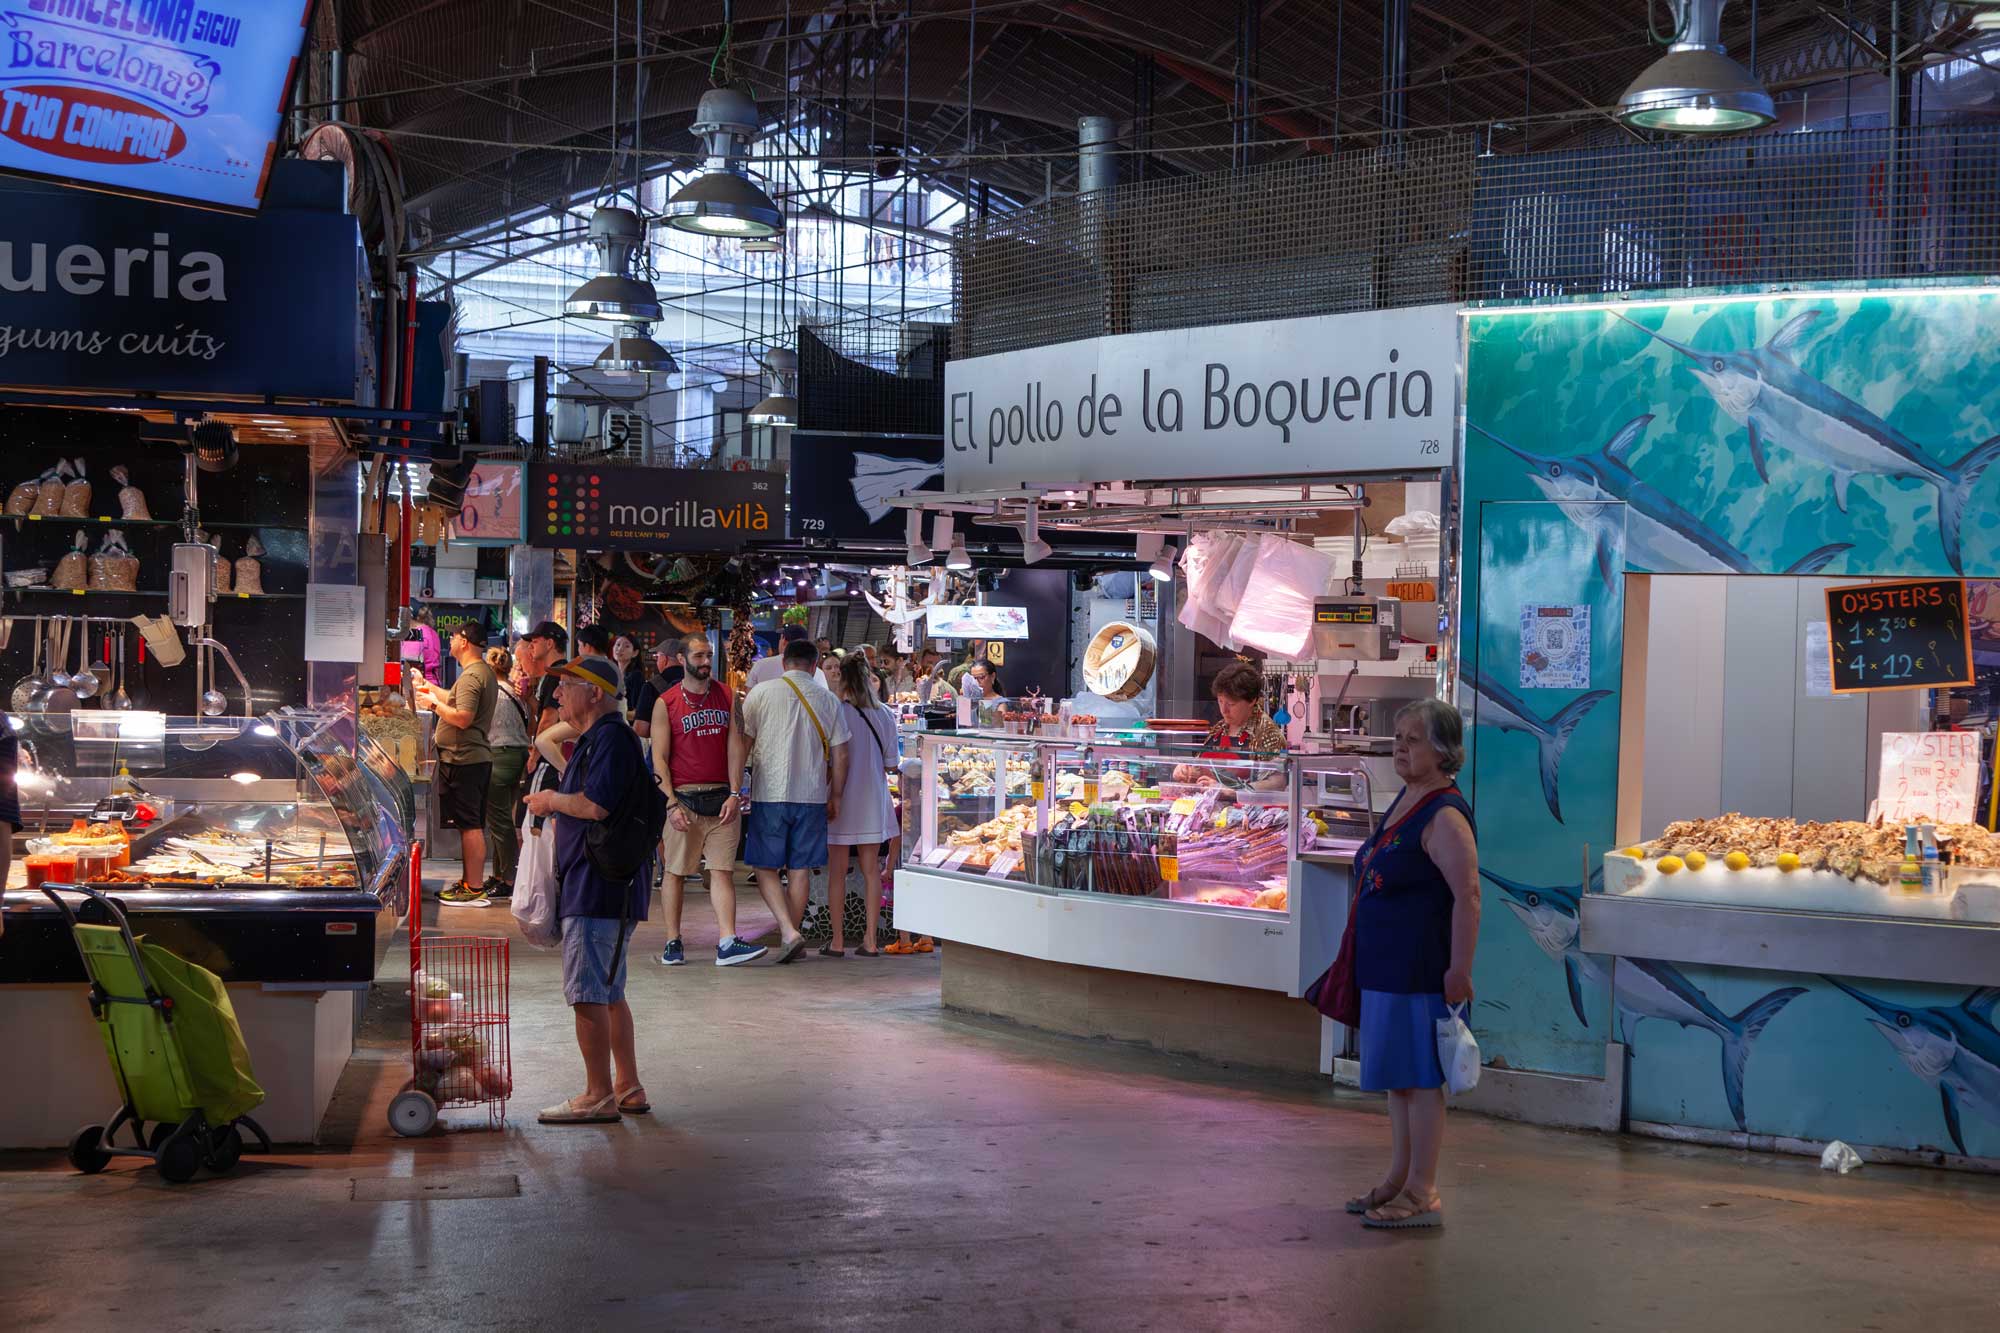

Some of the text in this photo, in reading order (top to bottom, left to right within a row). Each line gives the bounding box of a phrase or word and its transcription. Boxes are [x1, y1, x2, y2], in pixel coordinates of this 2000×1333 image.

[192, 10, 241, 48] SIGUI
[8, 30, 205, 105] Barcelona?
[64, 102, 175, 160] COMPRO!
[951, 391, 977, 451] El
[988, 382, 1064, 464] pollo
[1077, 374, 1122, 438] de
[1143, 369, 1183, 433] la
[1420, 440, 1440, 455] 728
[752, 482, 768, 490] 362
[609, 501, 769, 530] morillavilà
[802, 518, 825, 530] 729
[1841, 587, 1944, 613] OYSTERS
[1849, 620, 1864, 644] 1
[1850, 654, 1866, 680] 4
[681, 709, 729, 734] BOSTON
